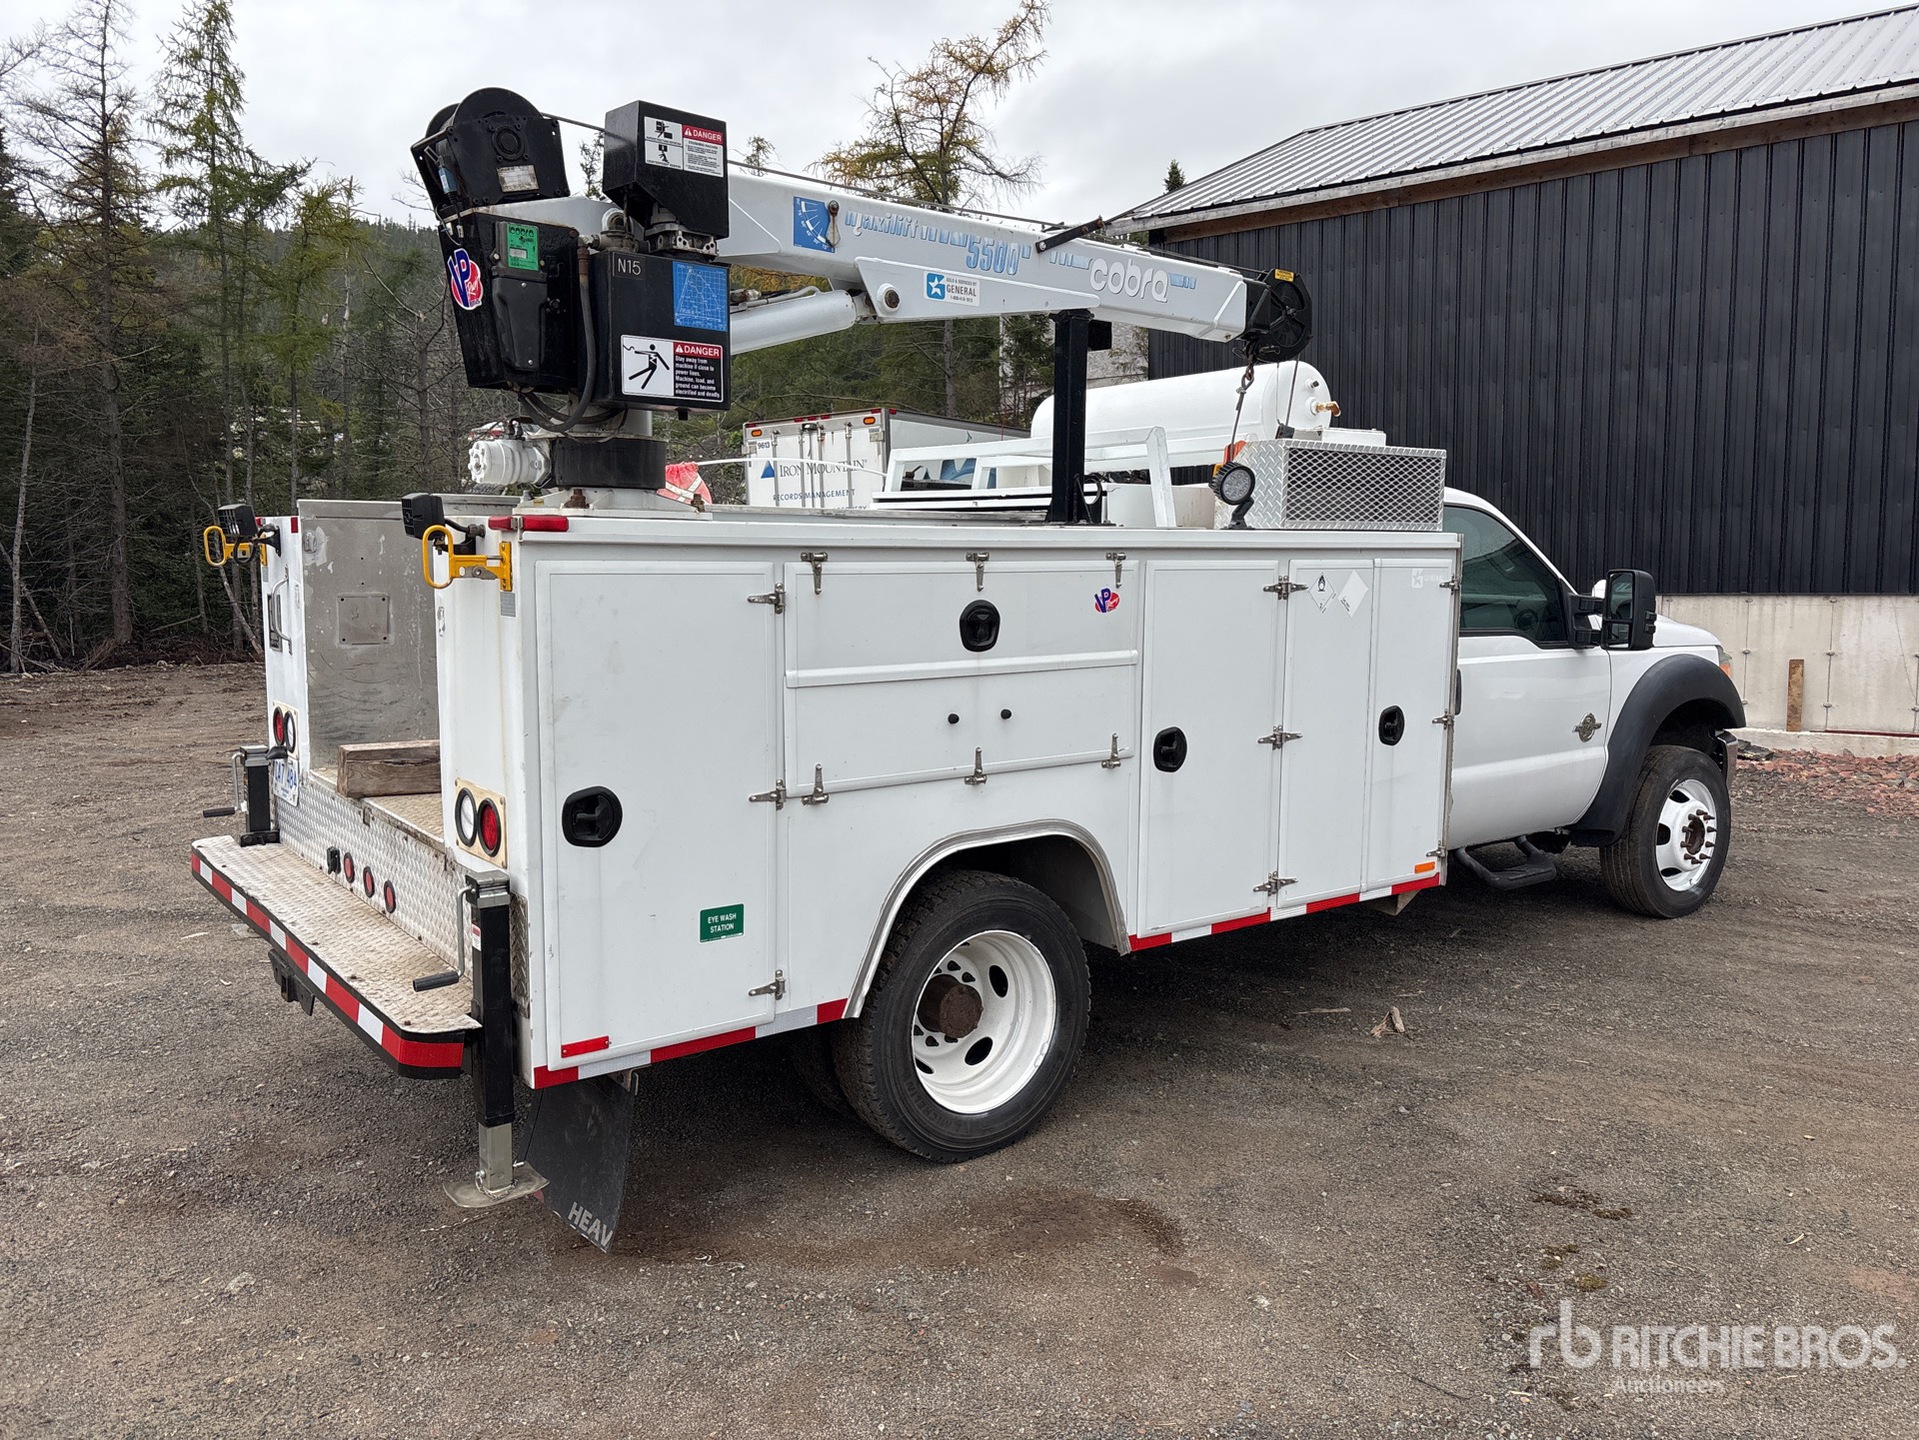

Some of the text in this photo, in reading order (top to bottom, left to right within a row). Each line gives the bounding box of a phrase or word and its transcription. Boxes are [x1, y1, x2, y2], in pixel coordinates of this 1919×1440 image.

[693, 129, 722, 142] DANGER
[966, 234, 1020, 276] 5500
[617, 258, 642, 276] N15
[1089, 257, 1169, 303] cobra
[946, 284, 977, 297] GENERAL
[684, 345, 720, 356] DANGER
[708, 912, 737, 924] EYE WASH
[710, 922, 735, 934] STATION
